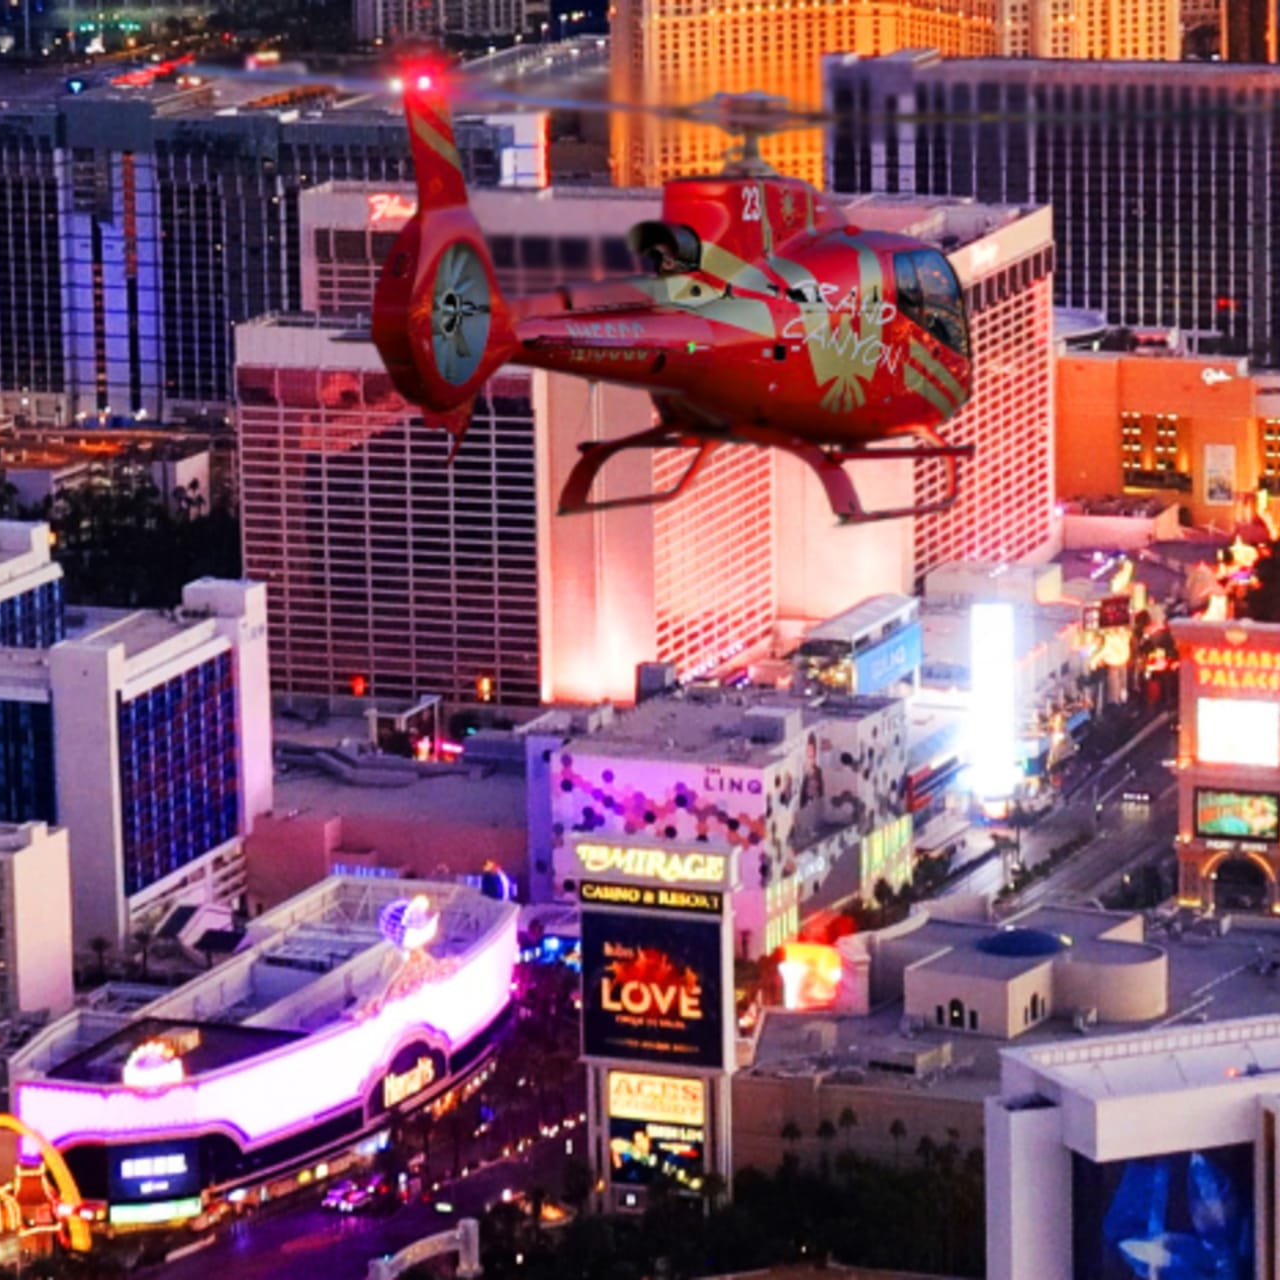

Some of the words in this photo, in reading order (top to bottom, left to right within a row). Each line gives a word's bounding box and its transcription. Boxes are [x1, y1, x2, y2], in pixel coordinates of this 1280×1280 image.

[742, 186, 760, 221] 23
[783, 315, 902, 375] CANYON
[1199, 669, 1280, 690] PALACE
[704, 775, 763, 795] LINQ
[585, 848, 725, 881] MIRAGE
[582, 884, 640, 902] CASINO
[601, 972, 703, 1019] LOVE
